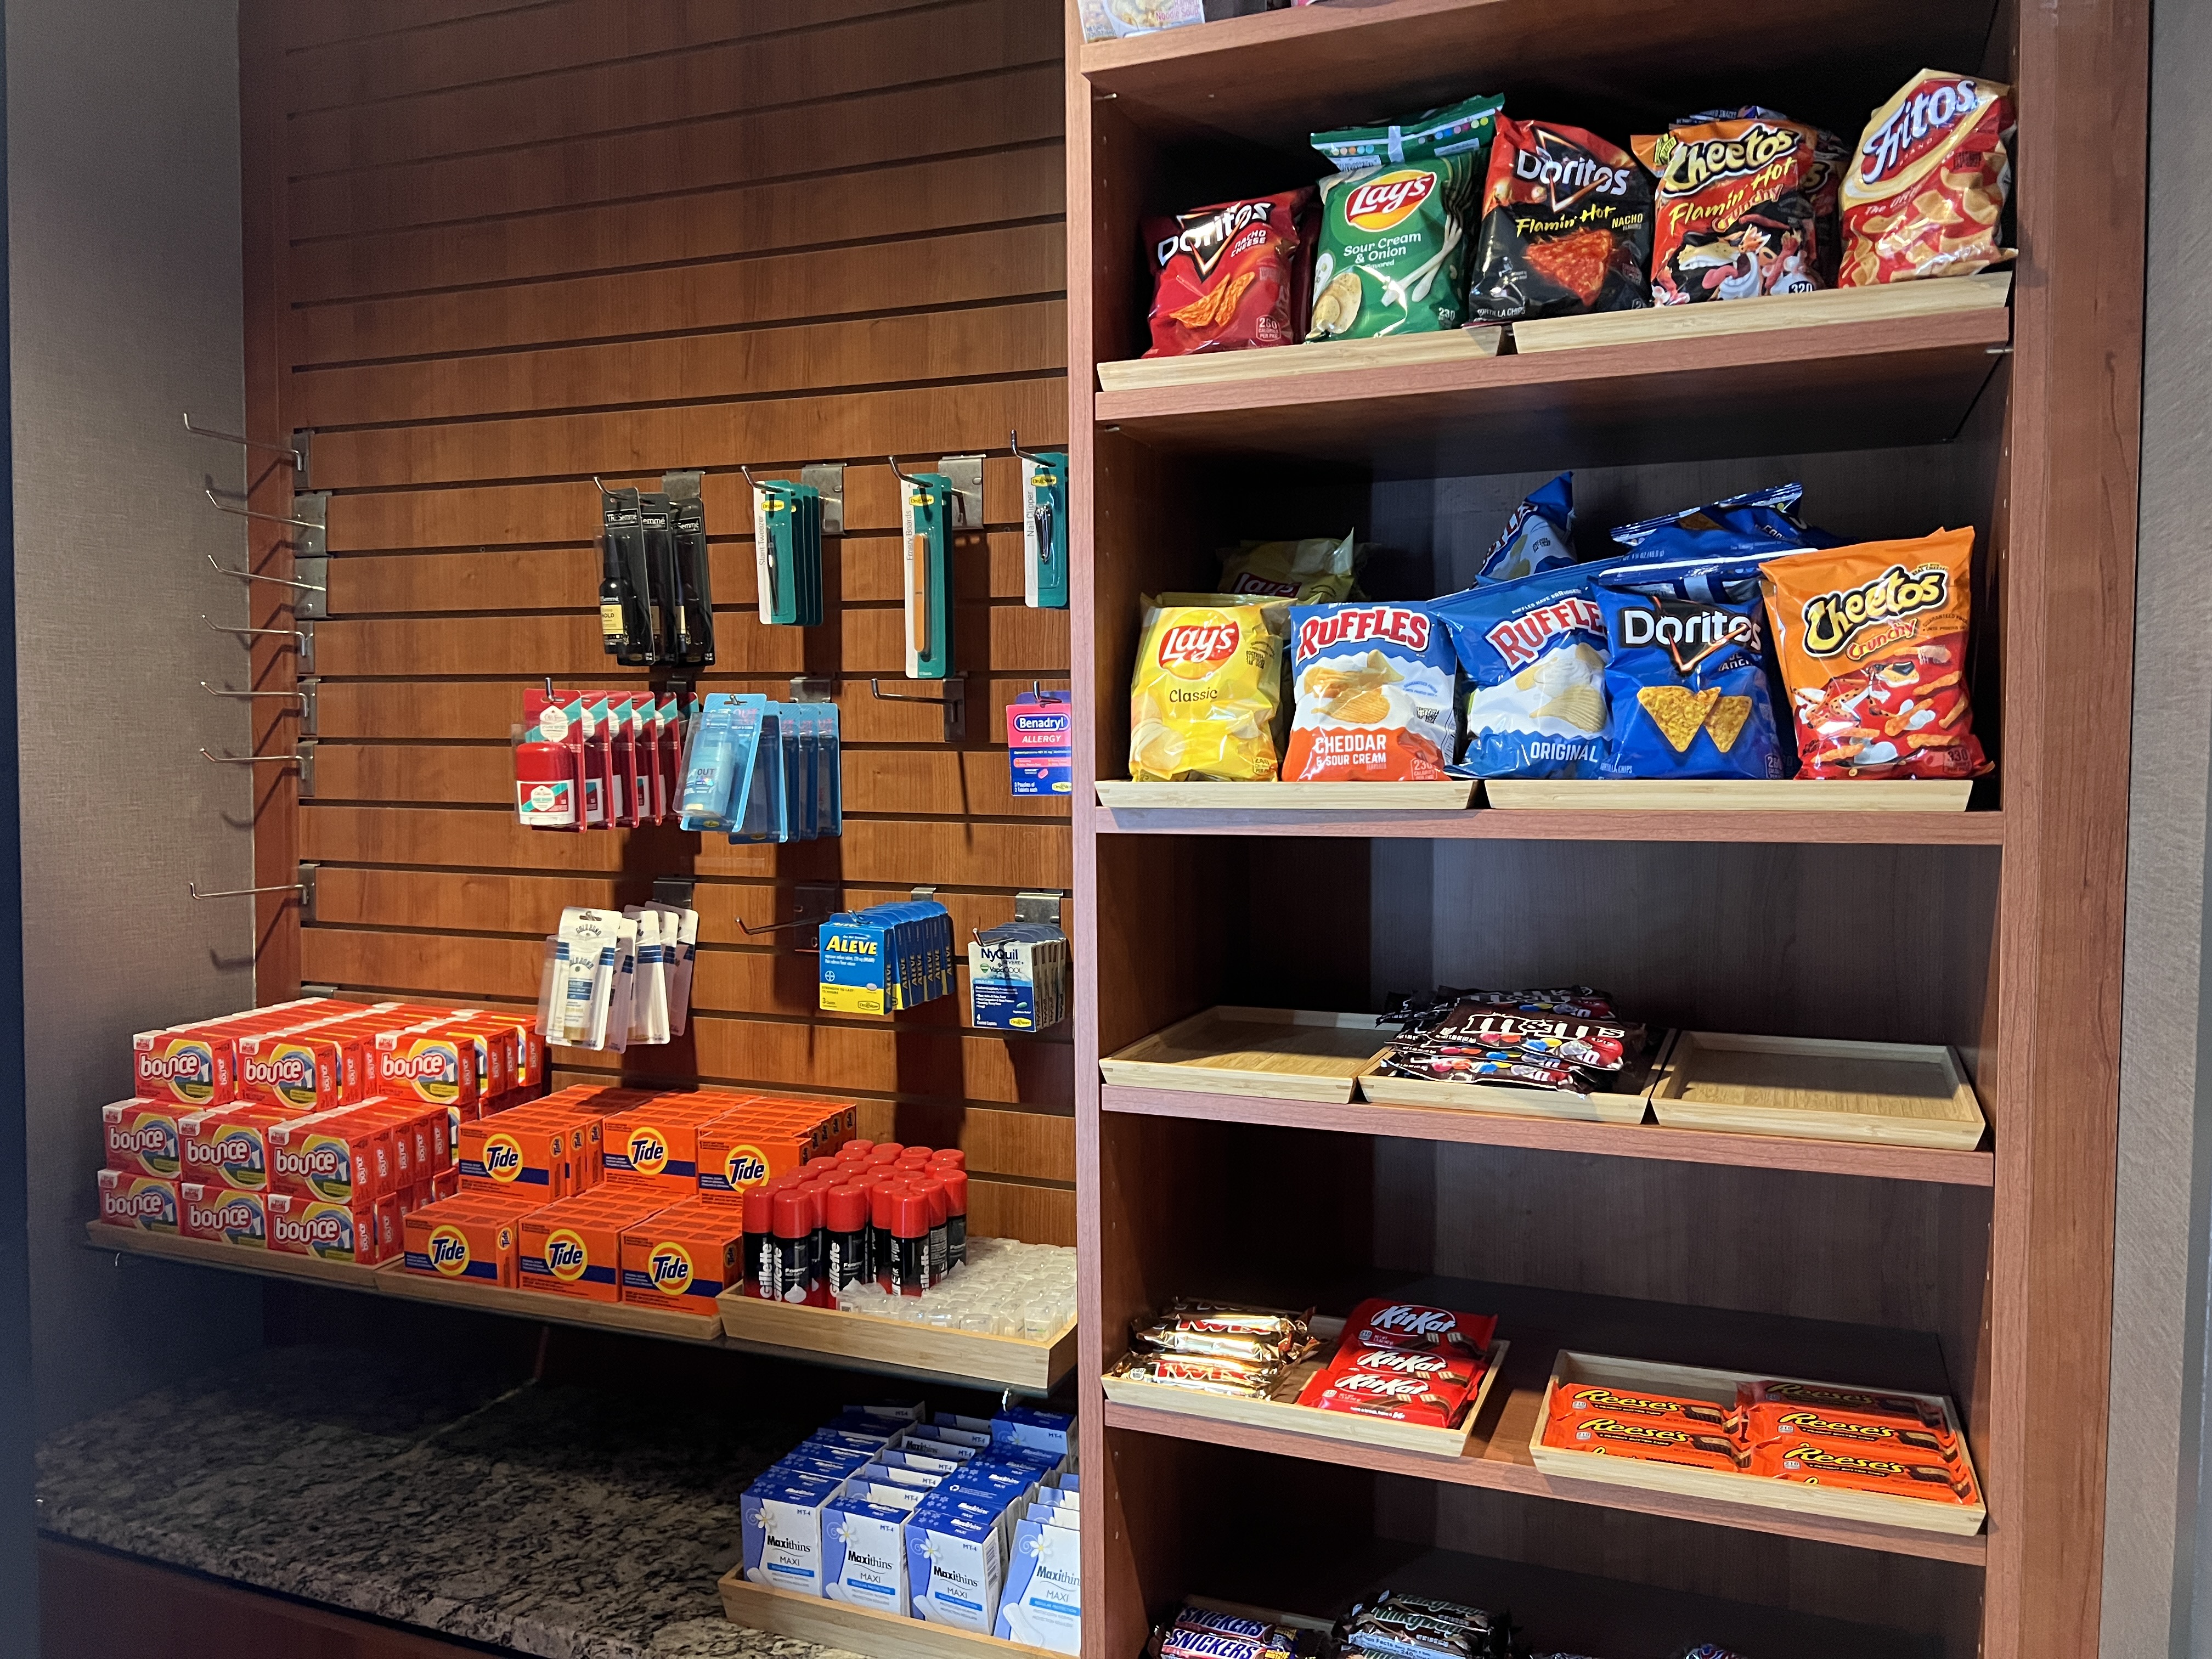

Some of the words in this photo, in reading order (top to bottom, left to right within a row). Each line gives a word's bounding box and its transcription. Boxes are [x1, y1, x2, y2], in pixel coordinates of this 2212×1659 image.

[1156, 9, 1180, 21] Noodle
[1181, 8, 1199, 18] Soup
[1862, 80, 1978, 183] Fritos
[1664, 127, 1799, 191] Cheetos
[1516, 148, 1630, 195] Doritos
[1350, 177, 1431, 216] Lay's
[1668, 188, 1748, 237] Flamin'
[1751, 156, 1797, 191] Hot
[1515, 213, 1577, 238] Flamin'
[1579, 204, 1616, 222] Hot
[1611, 213, 1644, 229] NACHO
[1158, 202, 1271, 267] Doritos
[1231, 236, 1266, 257] CHEESE
[1344, 242, 1375, 256] Sour
[1378, 233, 1421, 248] Cream
[1355, 253, 1365, 264] &
[1368, 246, 1407, 261] Onion
[1791, 283, 1813, 294] 320
[1259, 318, 1278, 329] 260
[1506, 307, 1526, 317] CHIPS
[1026, 491, 1036, 518] Clipper
[1027, 520, 1036, 537] Nail
[1808, 569, 1940, 651] Cheetos
[1162, 622, 1235, 663] Lay's
[1297, 609, 1429, 662] RUFFLES
[1490, 600, 1607, 666] RUFFLE
[1624, 610, 1761, 652] Doritos
[1847, 618, 1917, 659] Crunchy
[1718, 658, 1752, 672] ANC
[1169, 686, 1218, 703] Classic
[1019, 716, 1064, 731] Benadryl
[1022, 735, 1062, 743] ALLERGY
[1316, 734, 1387, 754] CHEDDAR
[1325, 754, 1350, 766] SOUR
[1352, 752, 1387, 765] CREAM
[1530, 742, 1598, 763] ORIGINAL
[826, 935, 878, 955] ALEVE
[981, 948, 1019, 962] NyQuil
[140, 1054, 199, 1078] bounce
[246, 1059, 303, 1083] bounce
[382, 1054, 444, 1078] bounce
[110, 1127, 163, 1151] bounce
[187, 1141, 248, 1164] bounce
[276, 1150, 335, 1175] bounce
[487, 1147, 518, 1171] Tide
[631, 1140, 664, 1164] Tide
[729, 1158, 765, 1185] Tide
[105, 1192, 161, 1216] bounce
[190, 1206, 249, 1229] bounce
[275, 1218, 338, 1243] bounce
[432, 1238, 465, 1265] Tide
[549, 1242, 583, 1269] Tide
[653, 1255, 689, 1284] Tide
[759, 1243, 773, 1299] Gillette
[830, 1240, 840, 1297] Gillette
[920, 1245, 929, 1291] illette
[1370, 1305, 1457, 1334] KitKat
[1356, 1351, 1447, 1373] KitKat
[1334, 1374, 1429, 1396] KitKat
[1574, 1390, 1682, 1412] Reese's
[1579, 1418, 1690, 1442] Reese's
[1779, 1413, 1896, 1437] Reese's
[972, 1436, 985, 1444] MT-4
[938, 1464, 952, 1472] MT-4
[1784, 1447, 1906, 1474] Reese's
[880, 1524, 894, 1532] MT-4
[767, 1534, 811, 1553] Maxithins
[963, 1543, 977, 1551] MT-4
[780, 1555, 800, 1566] MAXI
[848, 1550, 893, 1570] Maxithins
[860, 1572, 881, 1583] MAXI
[934, 1566, 979, 1587] Maxithins
[1036, 1565, 1080, 1587] Maxithin
[947, 1587, 968, 1599] MAXI
[1046, 1589, 1069, 1602] MAXI
[1179, 1606, 1263, 1637] SNICKERS
[1165, 1629, 1257, 1659] SNICKERS
